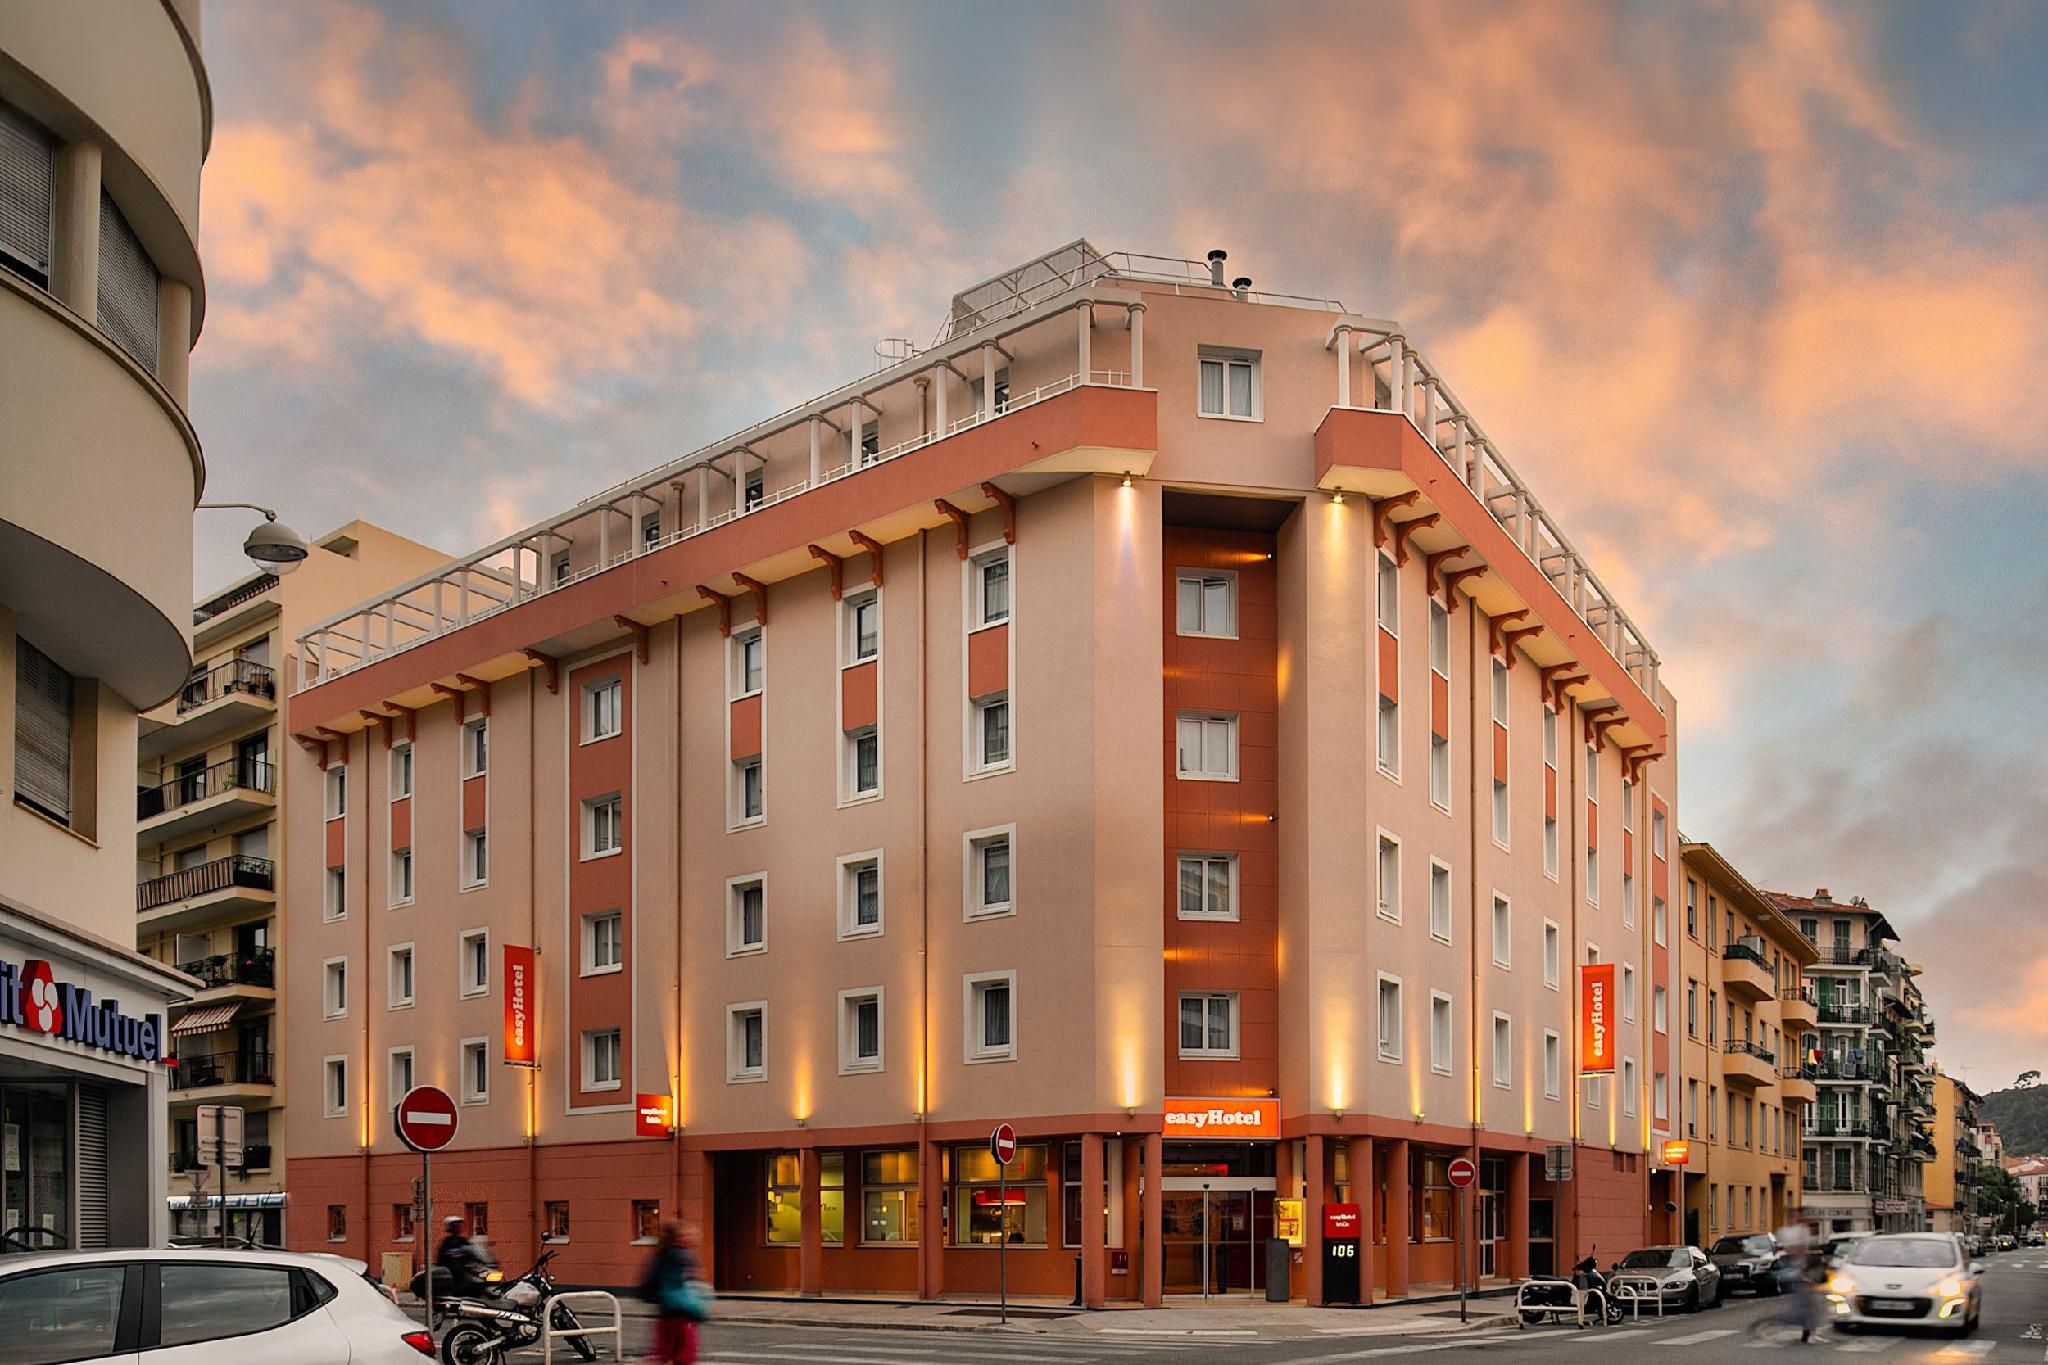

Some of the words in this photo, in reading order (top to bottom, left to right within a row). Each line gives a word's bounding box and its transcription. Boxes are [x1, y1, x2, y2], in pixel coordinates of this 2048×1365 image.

[64, 983, 161, 1062] Mutuel
[512, 964, 526, 1047] easyHotel
[1591, 981, 1606, 1057] easyHotel
[1165, 1109, 1262, 1129] easyHotel
[1332, 1244, 1355, 1258] 106
